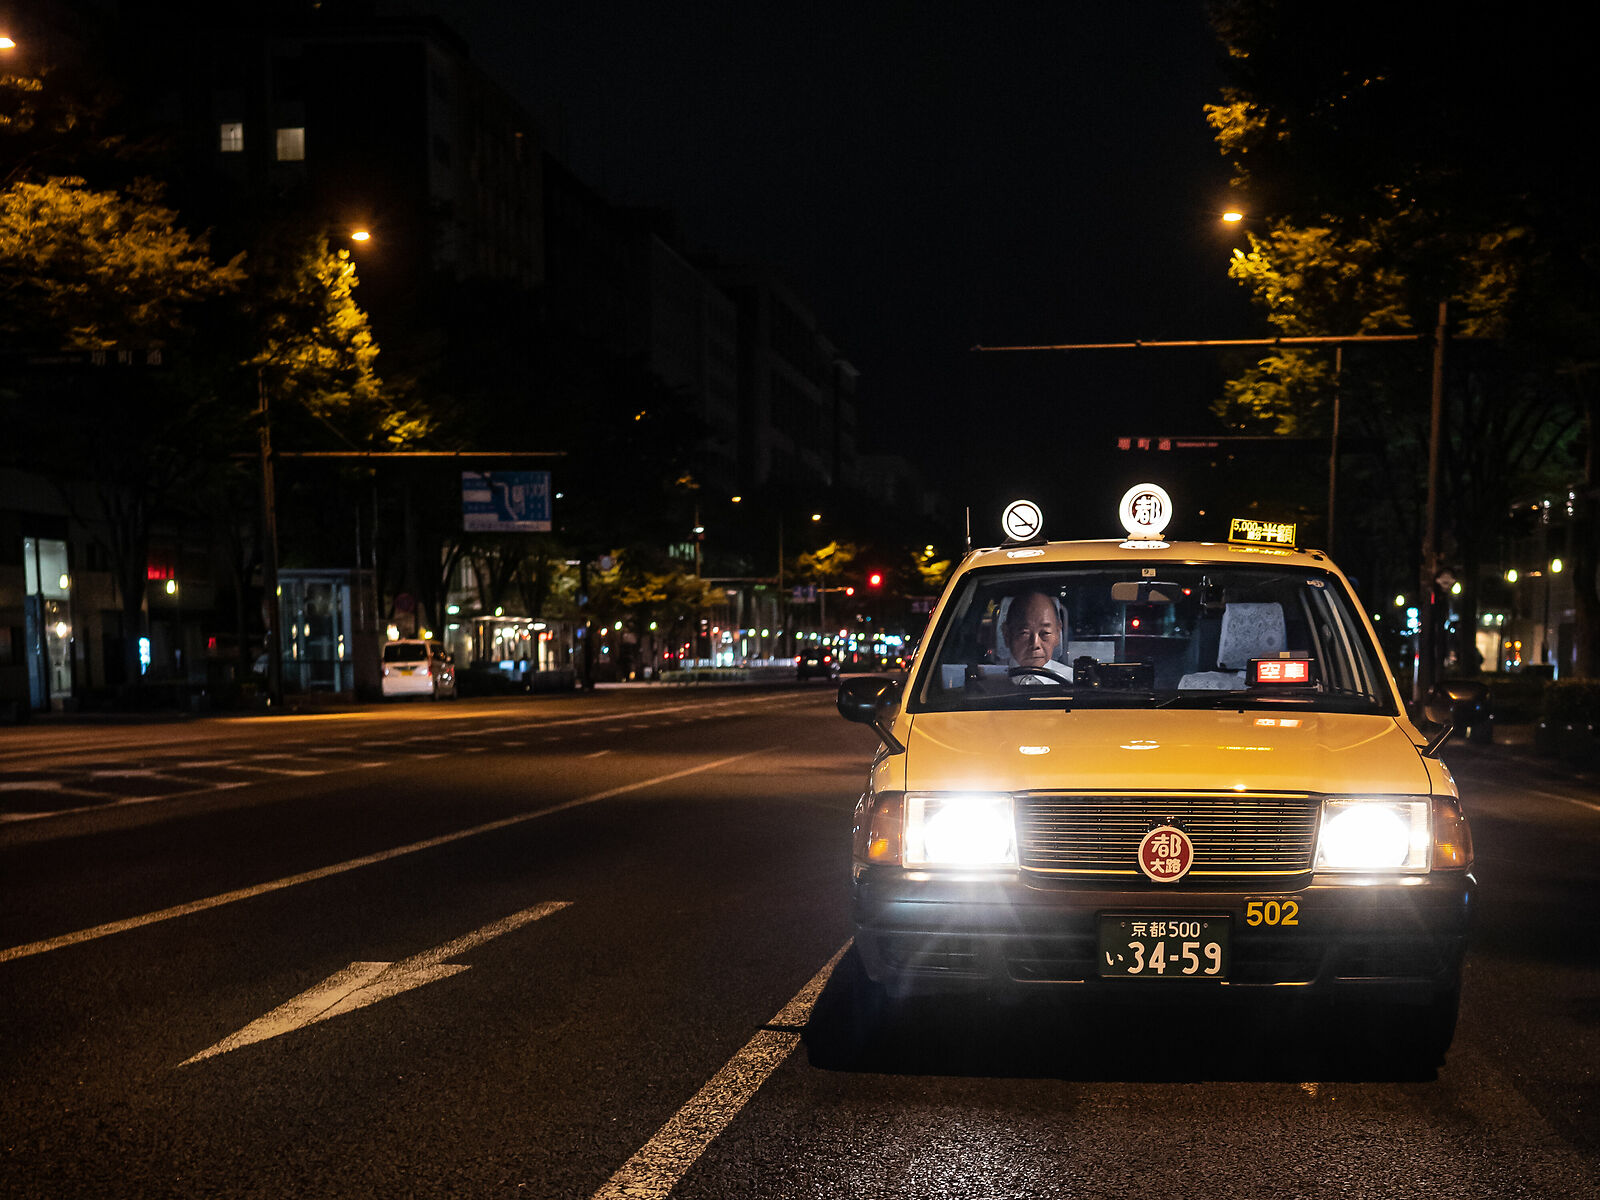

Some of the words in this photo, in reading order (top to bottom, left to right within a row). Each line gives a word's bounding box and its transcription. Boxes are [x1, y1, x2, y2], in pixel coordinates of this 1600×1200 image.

[1134, 496, 1161, 525] 都
[1262, 523, 1294, 543] 半額
[1260, 662, 1304, 678] 空車
[1151, 833, 1182, 858] 都
[1150, 859, 1182, 873] 大路
[1246, 901, 1299, 927] 502
[1131, 921, 1201, 938] 京都500
[1105, 951, 1124, 966] い
[1127, 941, 1222, 975] 34-59
